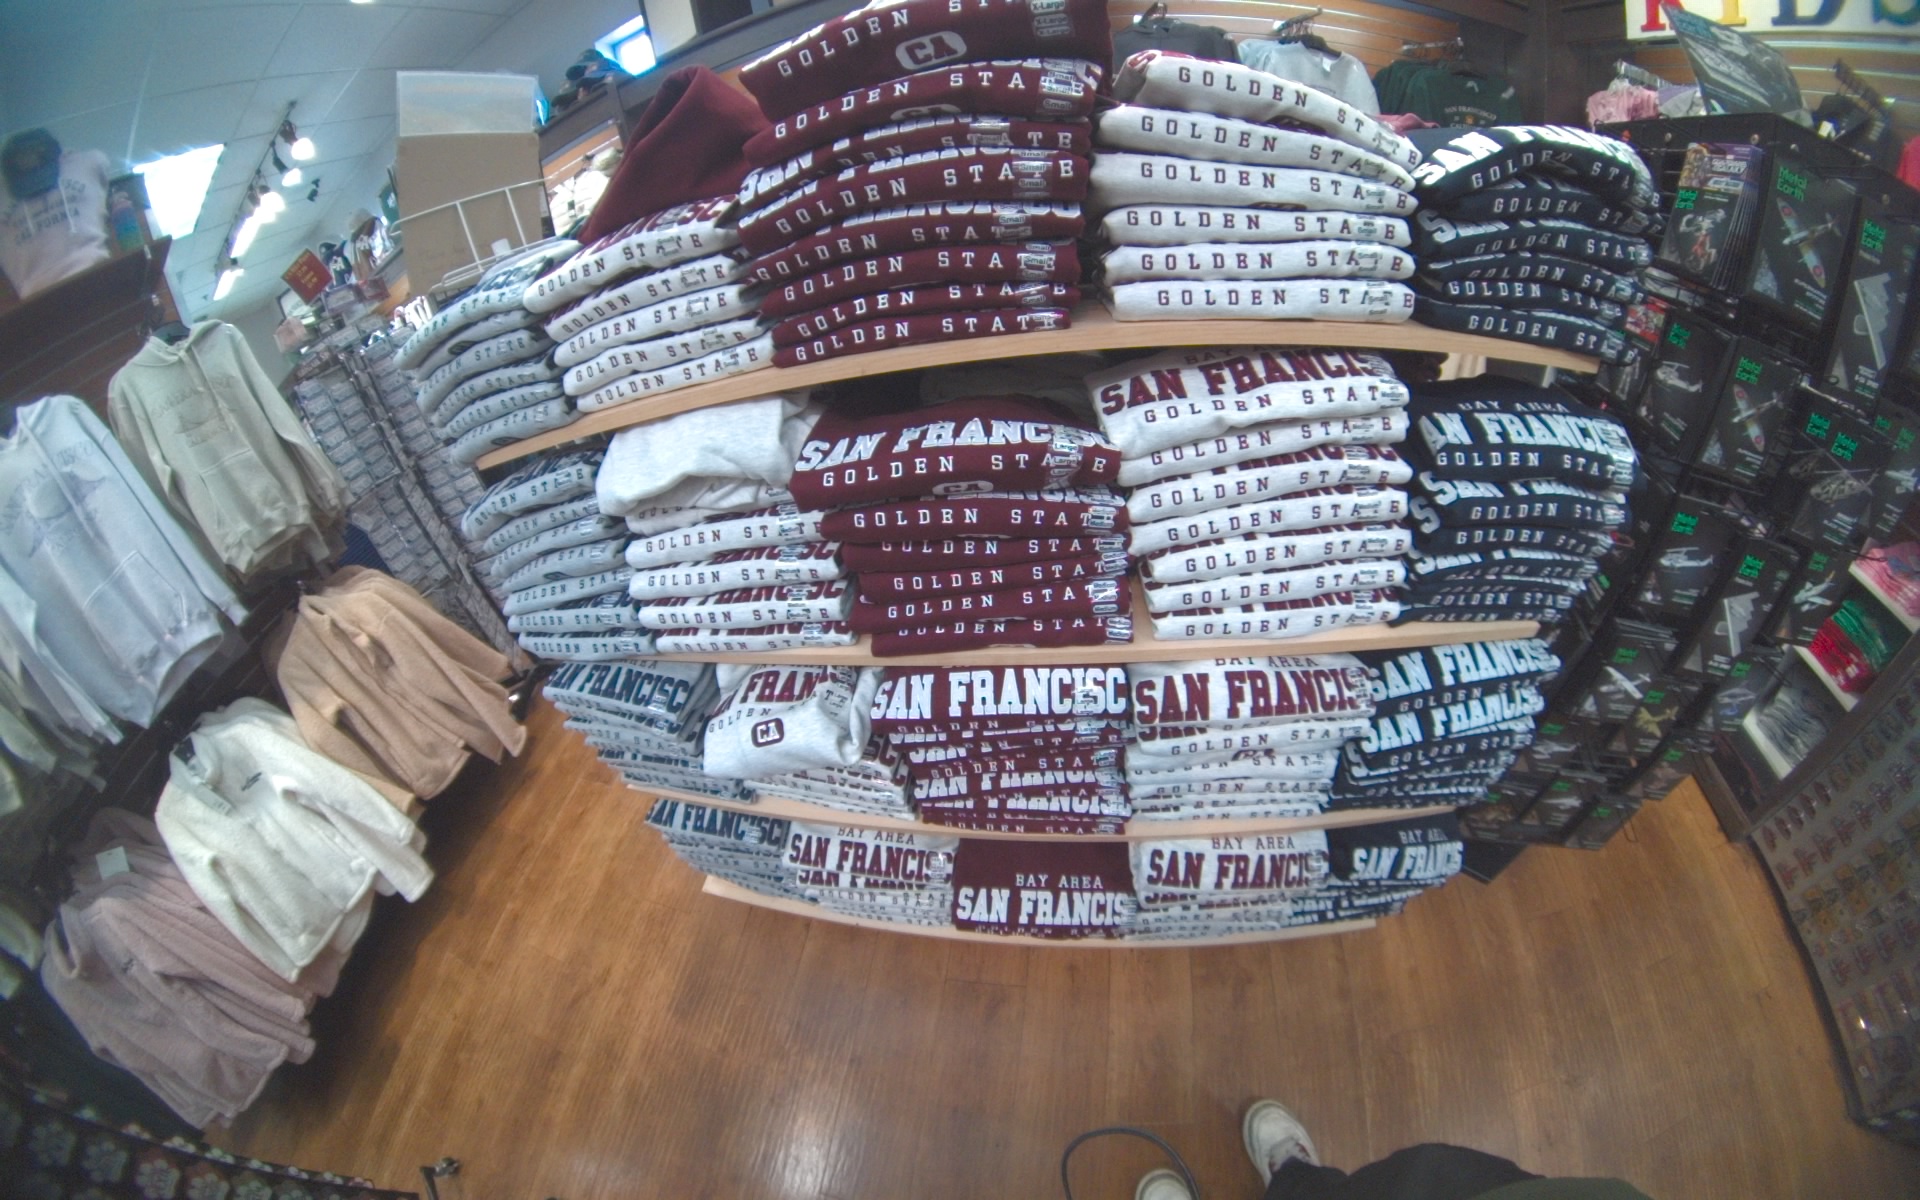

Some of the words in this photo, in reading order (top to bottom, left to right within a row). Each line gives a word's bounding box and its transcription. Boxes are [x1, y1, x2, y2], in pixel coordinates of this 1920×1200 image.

[778, 9, 909, 76] GOLDEN
[904, 36, 959, 66] CA
[1178, 66, 1308, 108] GOLDEN
[775, 82, 909, 138] GOLDEN
[1141, 115, 1279, 152] GOLDEN
[1141, 162, 1275, 188] GOLDEN
[1309, 177, 1409, 209] STAE
[1472, 150, 1572, 189] GOLDEN
[1591, 161, 1660, 208] STAE
[1777, 178, 1805, 202] Earth
[1779, 167, 1808, 189] Metal
[776, 178, 906, 233] GOLDEN
[944, 159, 1073, 186] STAE
[1493, 198, 1582, 213] GOLDEN
[1127, 210, 1261, 230] GOLDEN
[1295, 217, 1395, 239] STAE
[757, 235, 877, 280] GOLDEN
[1475, 234, 1568, 255] GOLDEN
[1141, 252, 1273, 270] GOLDEN
[1306, 250, 1403, 272] STAE
[1469, 266, 1565, 279] GOLDEN
[538, 258, 607, 296] GOLDEN
[784, 257, 902, 301] GOLDEN
[1449, 282, 1541, 296] GOLDEN
[460, 291, 506, 314] STAT
[798, 291, 914, 337] GOLDEN
[950, 283, 1066, 299] STAE
[1158, 289, 1287, 306] GOLDEN
[562, 294, 631, 334] GOLDEN
[1468, 315, 1558, 339] GOLDEN
[568, 320, 637, 353] GOLDEN
[796, 321, 909, 361] GOLDEN
[575, 350, 649, 383] GOLDEN
[595, 374, 665, 405] GOLDEN
[683, 347, 759, 381] STATE
[1100, 368, 1189, 416] SAN
[1144, 393, 1273, 423] GOLDEN
[1302, 386, 1380, 405] STAT
[1151, 430, 1272, 466] GOLDEN
[1301, 416, 1393, 439] STAE
[1418, 412, 1473, 457] AN
[795, 432, 887, 472] SAN
[1436, 452, 1540, 466] GOLDEN
[1563, 454, 1616, 478] STAT
[822, 456, 954, 487] GOLDEN
[1151, 476, 1269, 508] GOLDEN
[1299, 469, 1390, 484] STAE
[854, 508, 978, 528] GOLDEN
[1167, 509, 1283, 541] GOLDEN
[1311, 501, 1399, 520] STAE
[1471, 503, 1558, 520] GOLDEN
[646, 529, 721, 552] GOLDEN
[1028, 538, 1102, 554] STAT
[1457, 529, 1545, 544] GOLDEN
[1186, 544, 1296, 572] GOLDEN
[1324, 538, 1404, 555] STAE
[516, 584, 566, 603] GOLDEN
[579, 573, 618, 589] STAT
[647, 570, 721, 587] GOLDEN
[894, 569, 1004, 591] GOLDEN
[1032, 560, 1105, 580] STAT
[1182, 581, 1290, 605] GOLDEN
[1315, 569, 1395, 588] STAE
[888, 594, 993, 619] GOLDEN
[1023, 584, 1094, 604] STAT
[1430, 593, 1509, 606] GOLDEN
[519, 614, 563, 626] GOLDEN
[575, 613, 622, 625] STAE
[658, 611, 732, 624] GOLDEN
[1186, 617, 1289, 636] GOLDEN
[577, 664, 690, 714] FRANCISC
[870, 674, 934, 720] SAN
[949, 667, 1126, 716] FRANCISC
[1136, 673, 1210, 724] SAN
[1224, 667, 1359, 719] FRANCIS
[1399, 687, 1483, 712] GOLDEN
[709, 708, 772, 733] GOLDEN
[756, 723, 780, 743] CA
[1171, 734, 1269, 756] GOLDEN
[1390, 743, 1466, 766] GOLDEN
[931, 760, 1015, 779] GOLDEN
[788, 833, 831, 869] SAN
[874, 831, 915, 845] AREA
[1212, 837, 1243, 850] BAY
[1256, 836, 1295, 850] AREA
[1147, 849, 1205, 889] SAN
[1353, 847, 1399, 879] SAN
[1016, 874, 1048, 888] BAY
[1058, 875, 1104, 889] AREA
[956, 887, 1010, 923] SAN
[1018, 890, 1131, 927] FRANCIS
